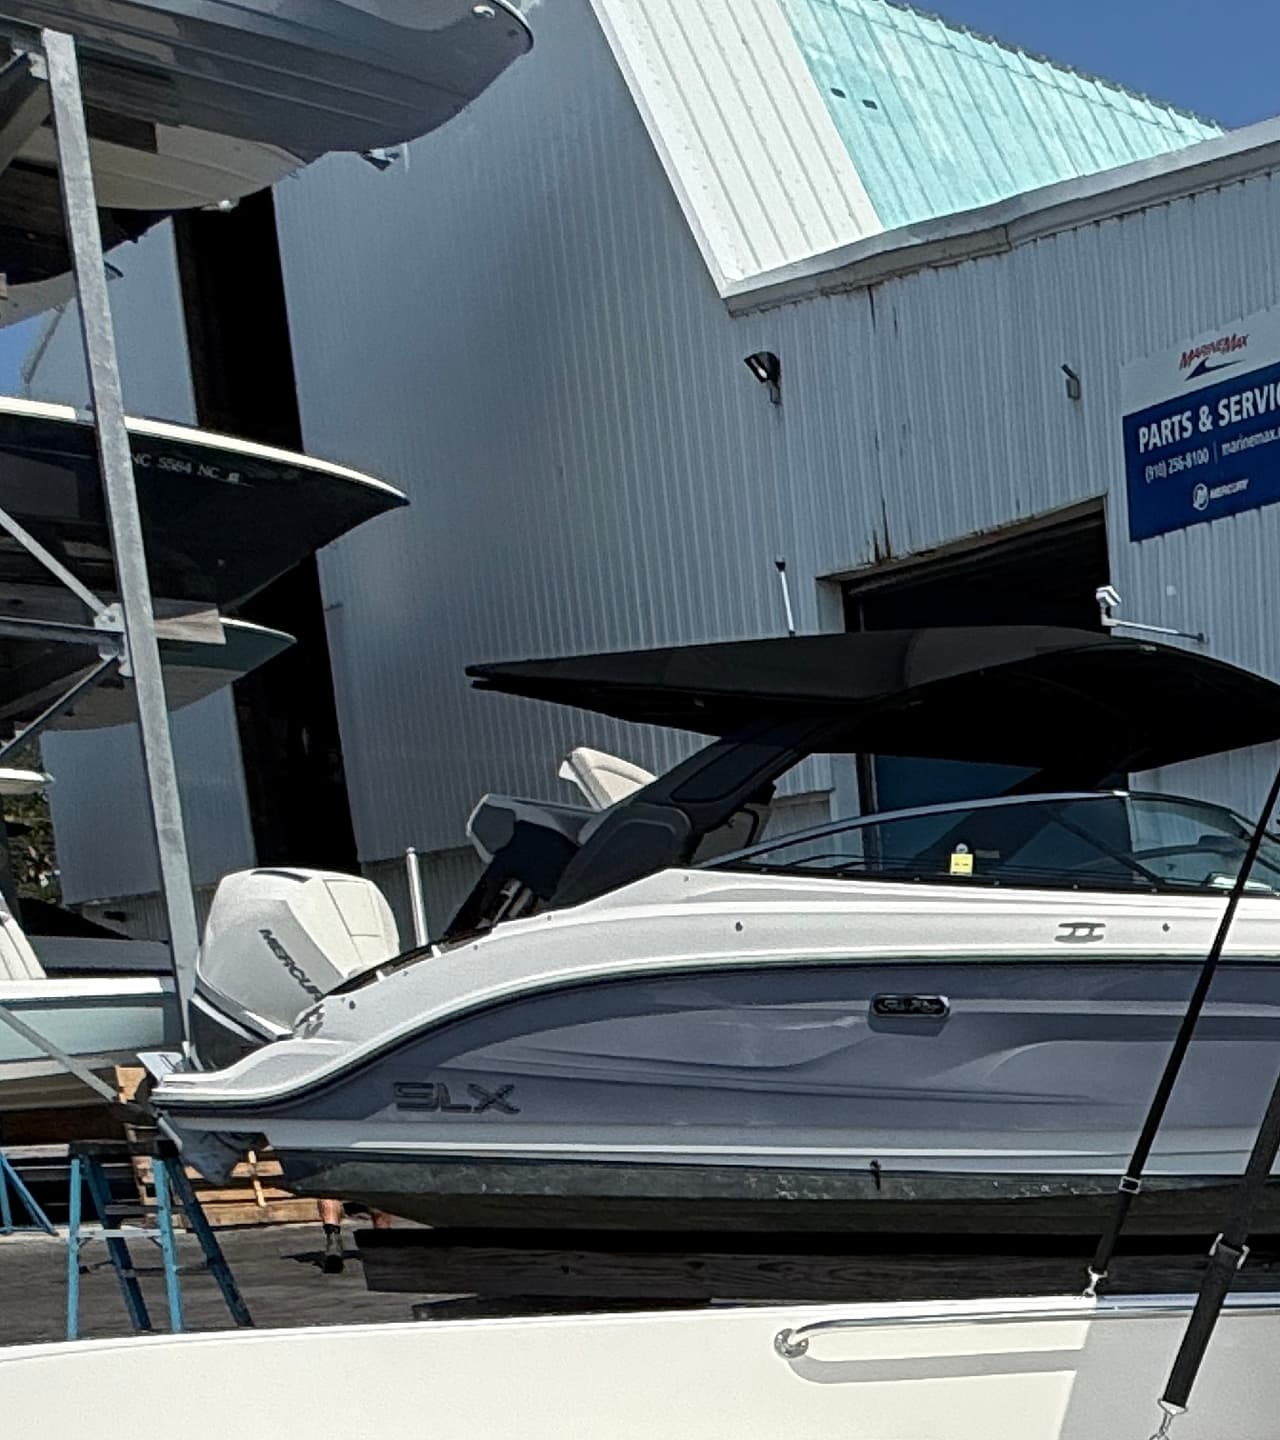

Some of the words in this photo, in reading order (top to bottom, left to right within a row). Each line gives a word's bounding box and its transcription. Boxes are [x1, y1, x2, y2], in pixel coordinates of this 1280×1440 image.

[1138, 410, 1193, 454] PARTS
[1198, 404, 1213, 433] &
[258, 928, 325, 1003] MERCUR
[392, 1081, 521, 1115] SLX
